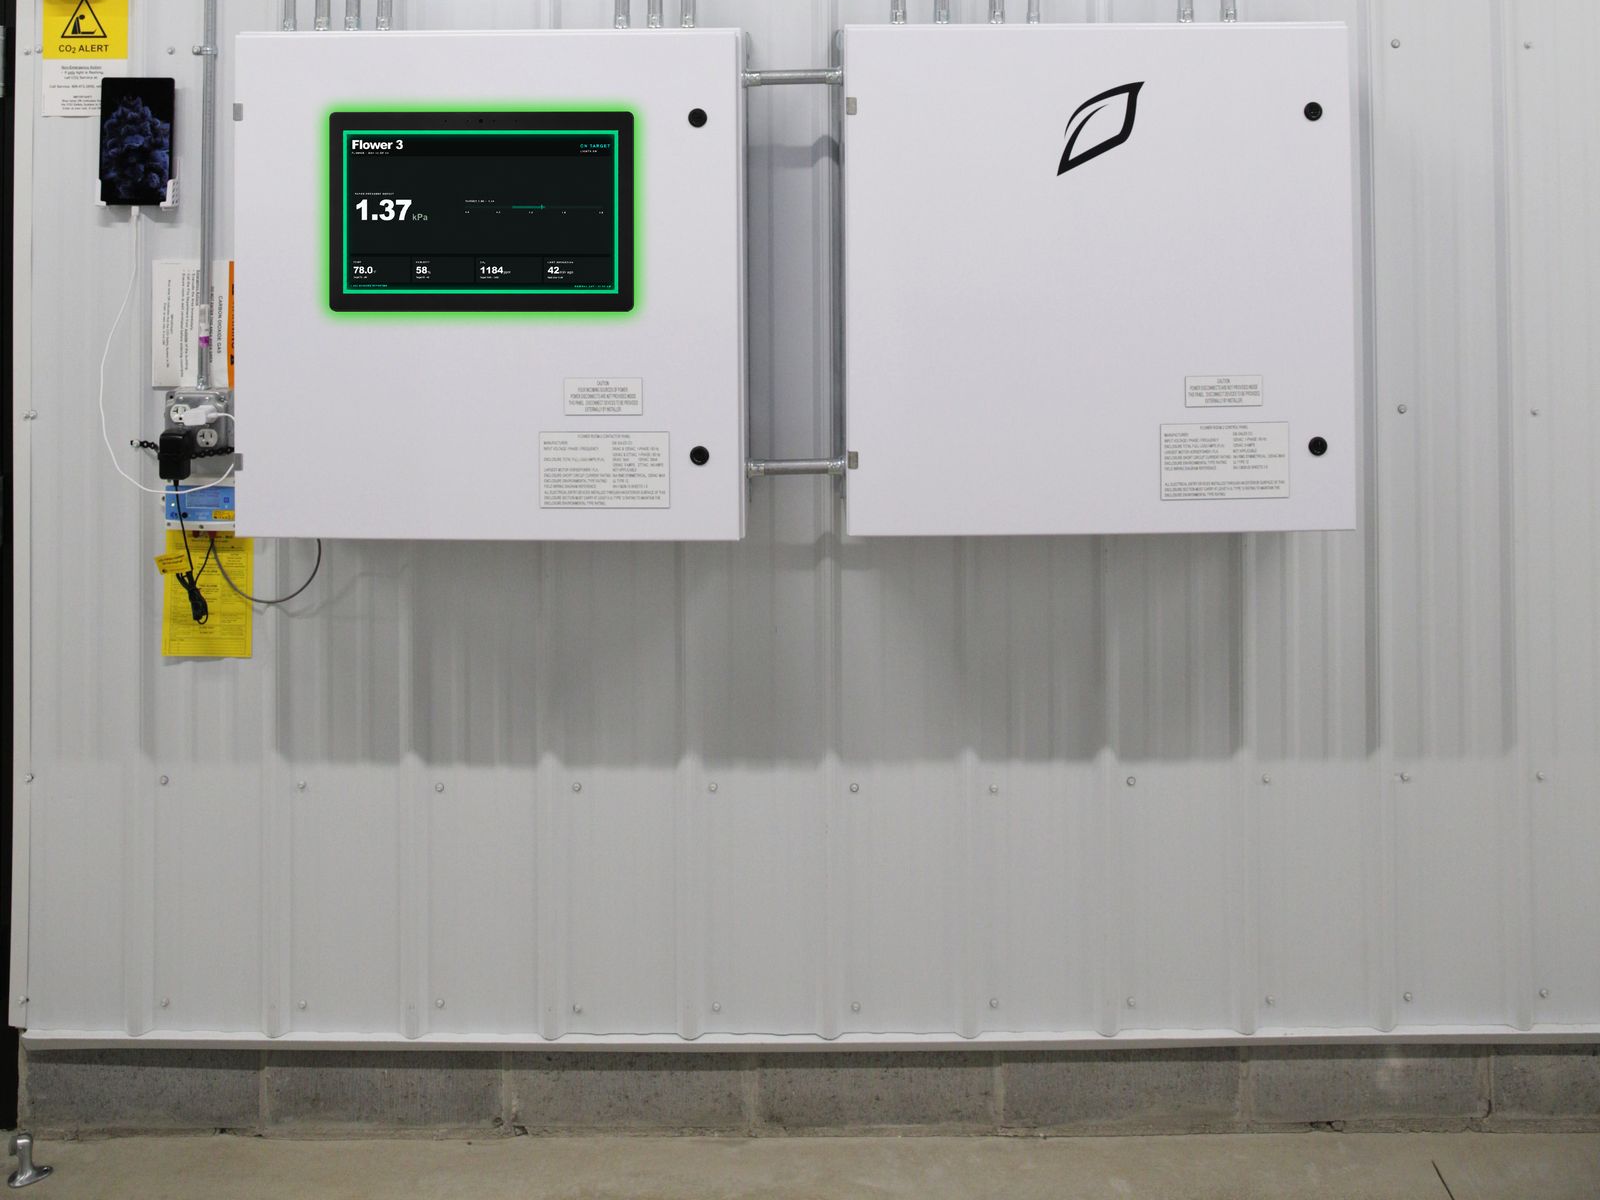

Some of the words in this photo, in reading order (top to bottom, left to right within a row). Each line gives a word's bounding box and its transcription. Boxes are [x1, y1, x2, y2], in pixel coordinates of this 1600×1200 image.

[79, 44, 109, 53] ALERT
[352, 140, 393, 150] Flower
[396, 140, 403, 150] 3
[356, 199, 412, 221] 1.37
[353, 266, 373, 274] 78.0
[416, 266, 428, 274] 58
